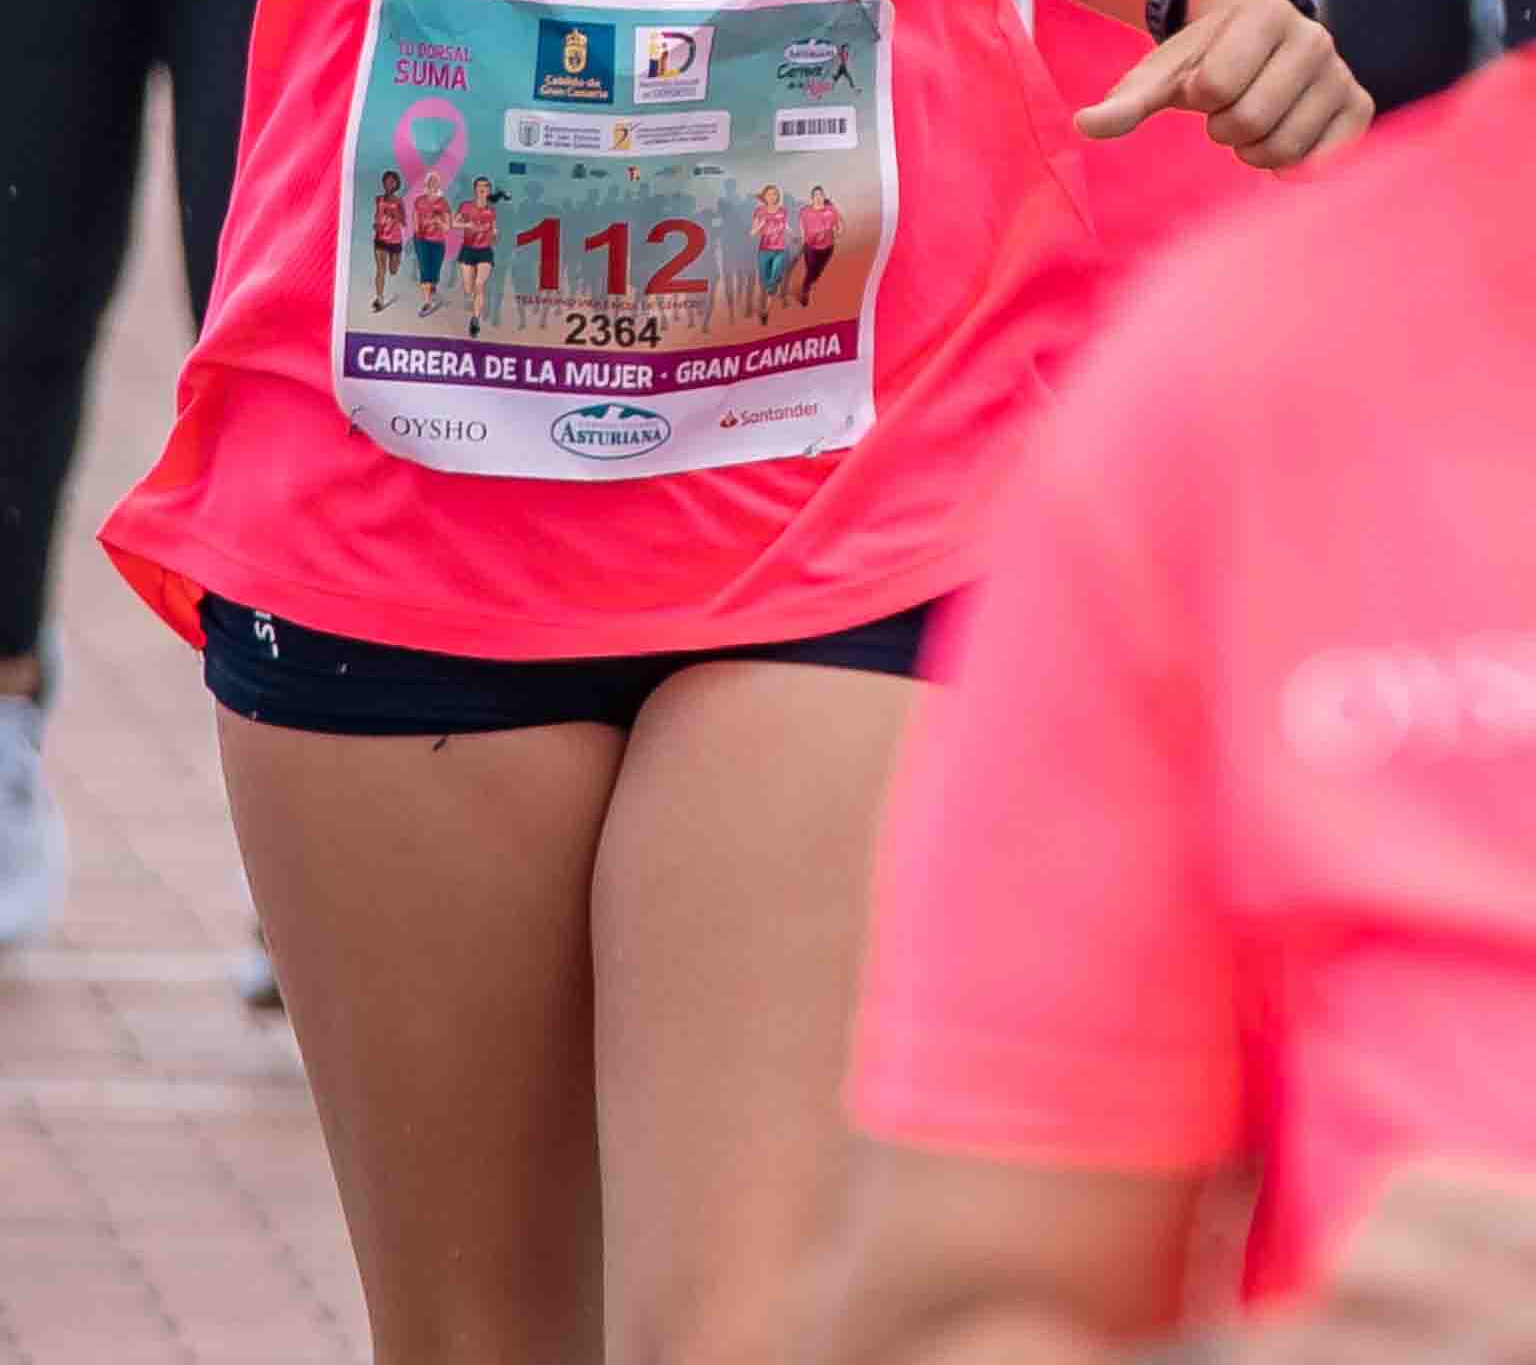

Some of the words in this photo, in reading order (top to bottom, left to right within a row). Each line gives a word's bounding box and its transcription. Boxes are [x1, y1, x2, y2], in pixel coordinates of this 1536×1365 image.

[393, 59, 468, 92] SUMA
[516, 216, 709, 295] 112
[565, 313, 661, 348] 2364
[357, 346, 476, 378] CARRERA
[484, 355, 517, 381] DE
[525, 359, 557, 385] LA
[565, 361, 653, 388] MUJER
[675, 355, 740, 384] GRAN
[745, 332, 842, 372] CANARIA
[391, 415, 488, 443] OYSHO
[740, 402, 818, 427] Santander
[561, 420, 662, 446] ASTURIANA
